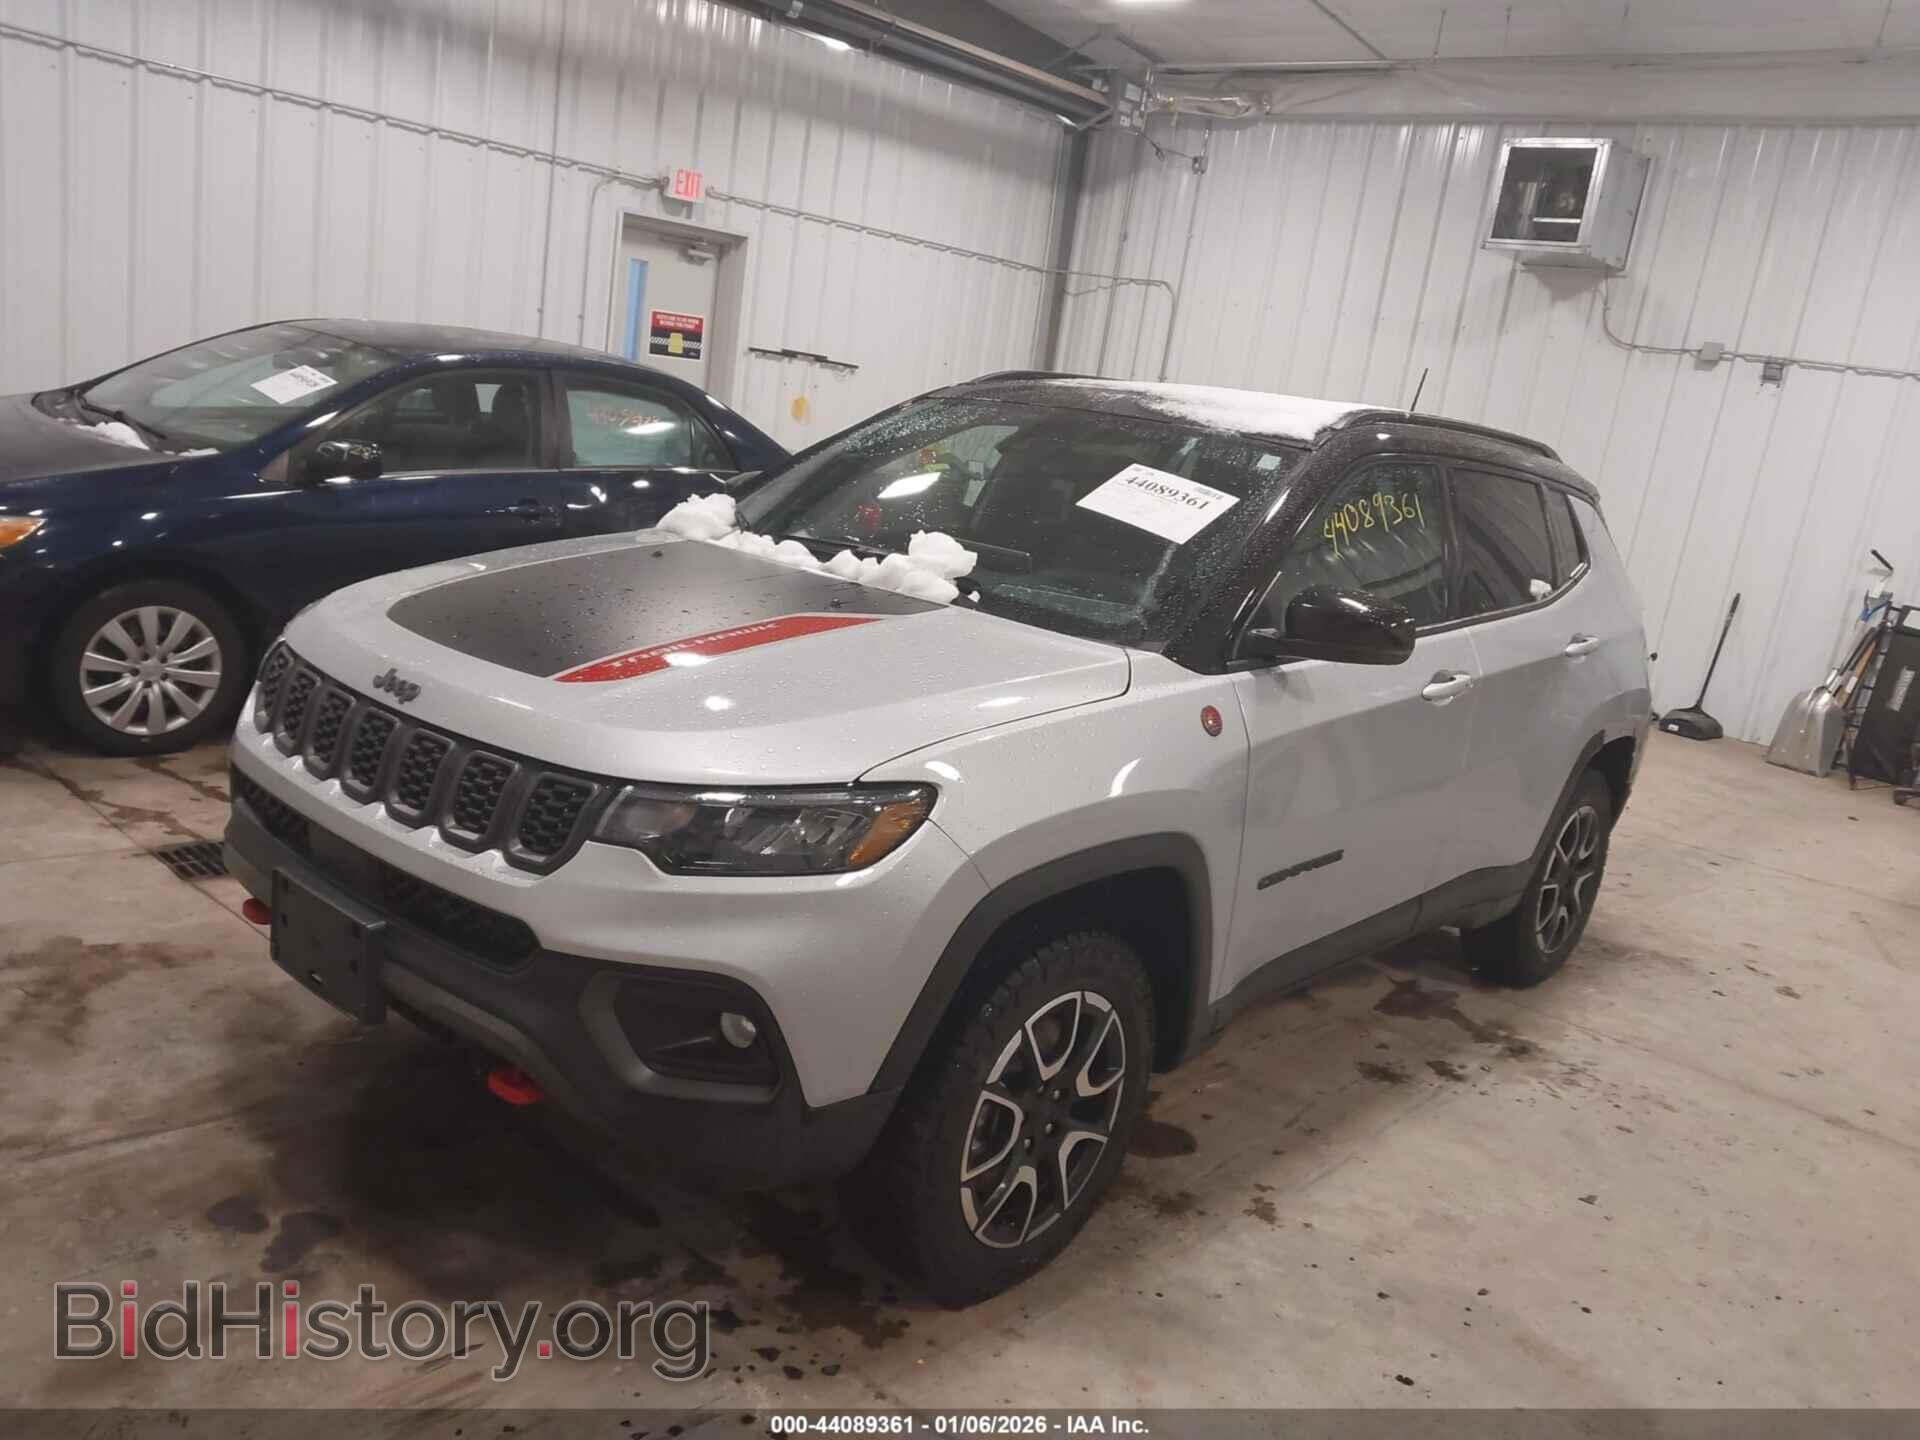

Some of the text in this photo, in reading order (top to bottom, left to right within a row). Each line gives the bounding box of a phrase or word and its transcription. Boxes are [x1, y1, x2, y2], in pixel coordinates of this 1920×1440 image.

[676, 169, 701, 198] EXIT
[1126, 476, 1210, 510] 44089361
[1323, 491, 1425, 560] 44089361
[373, 668, 422, 705] Jeep
